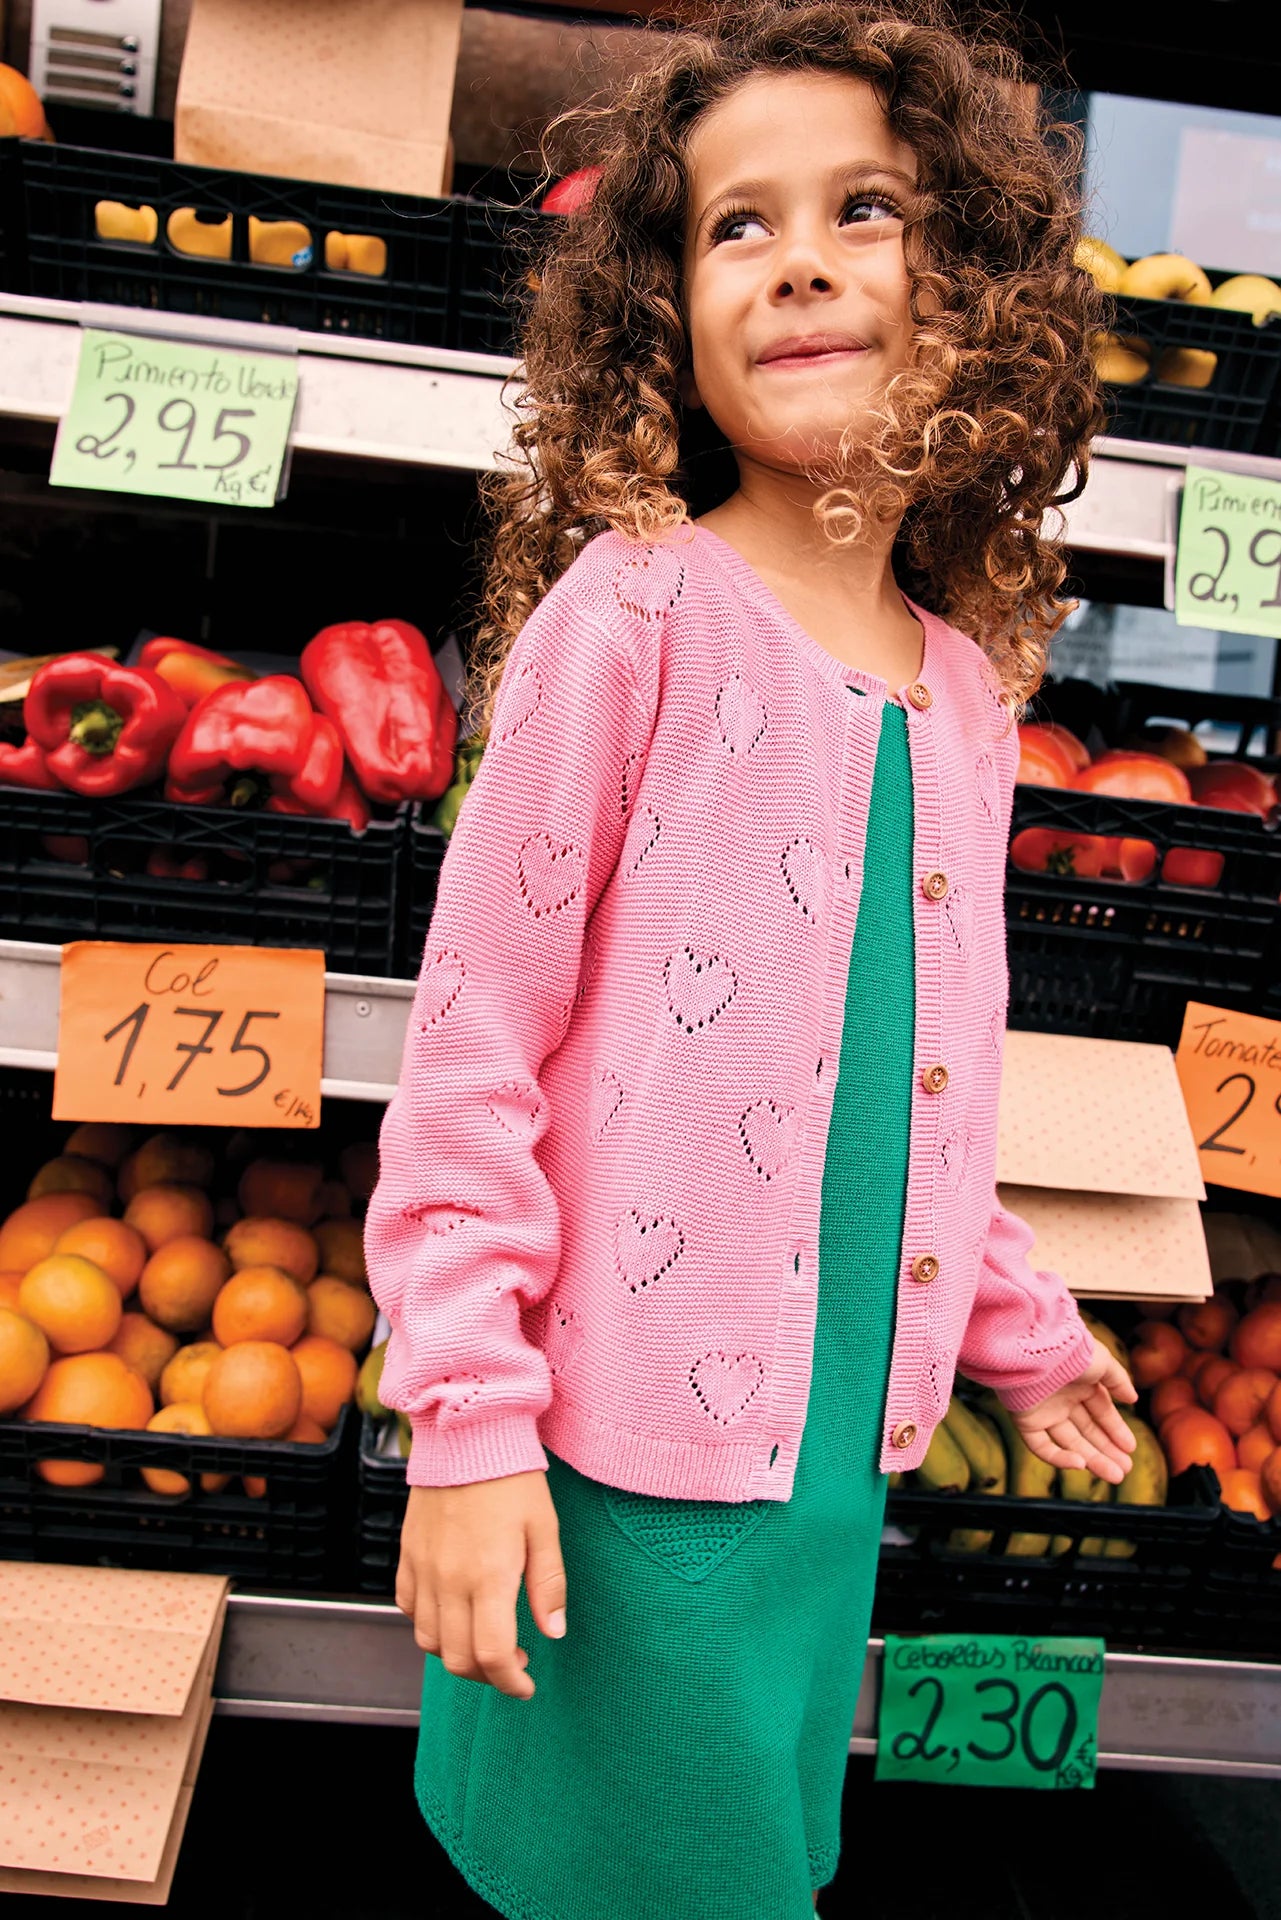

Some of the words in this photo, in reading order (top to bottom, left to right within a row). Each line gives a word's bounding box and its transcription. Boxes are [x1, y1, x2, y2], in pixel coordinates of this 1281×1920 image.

[94, 341, 231, 393] Pimiento
[76, 393, 256, 474] 2,95
[1193, 477, 1281, 519] Pimien
[144, 951, 219, 997] Col
[103, 1002, 281, 1098] 1,75
[1199, 1073, 1281, 1166] 2,
[892, 1676, 1077, 1772] 2,30
